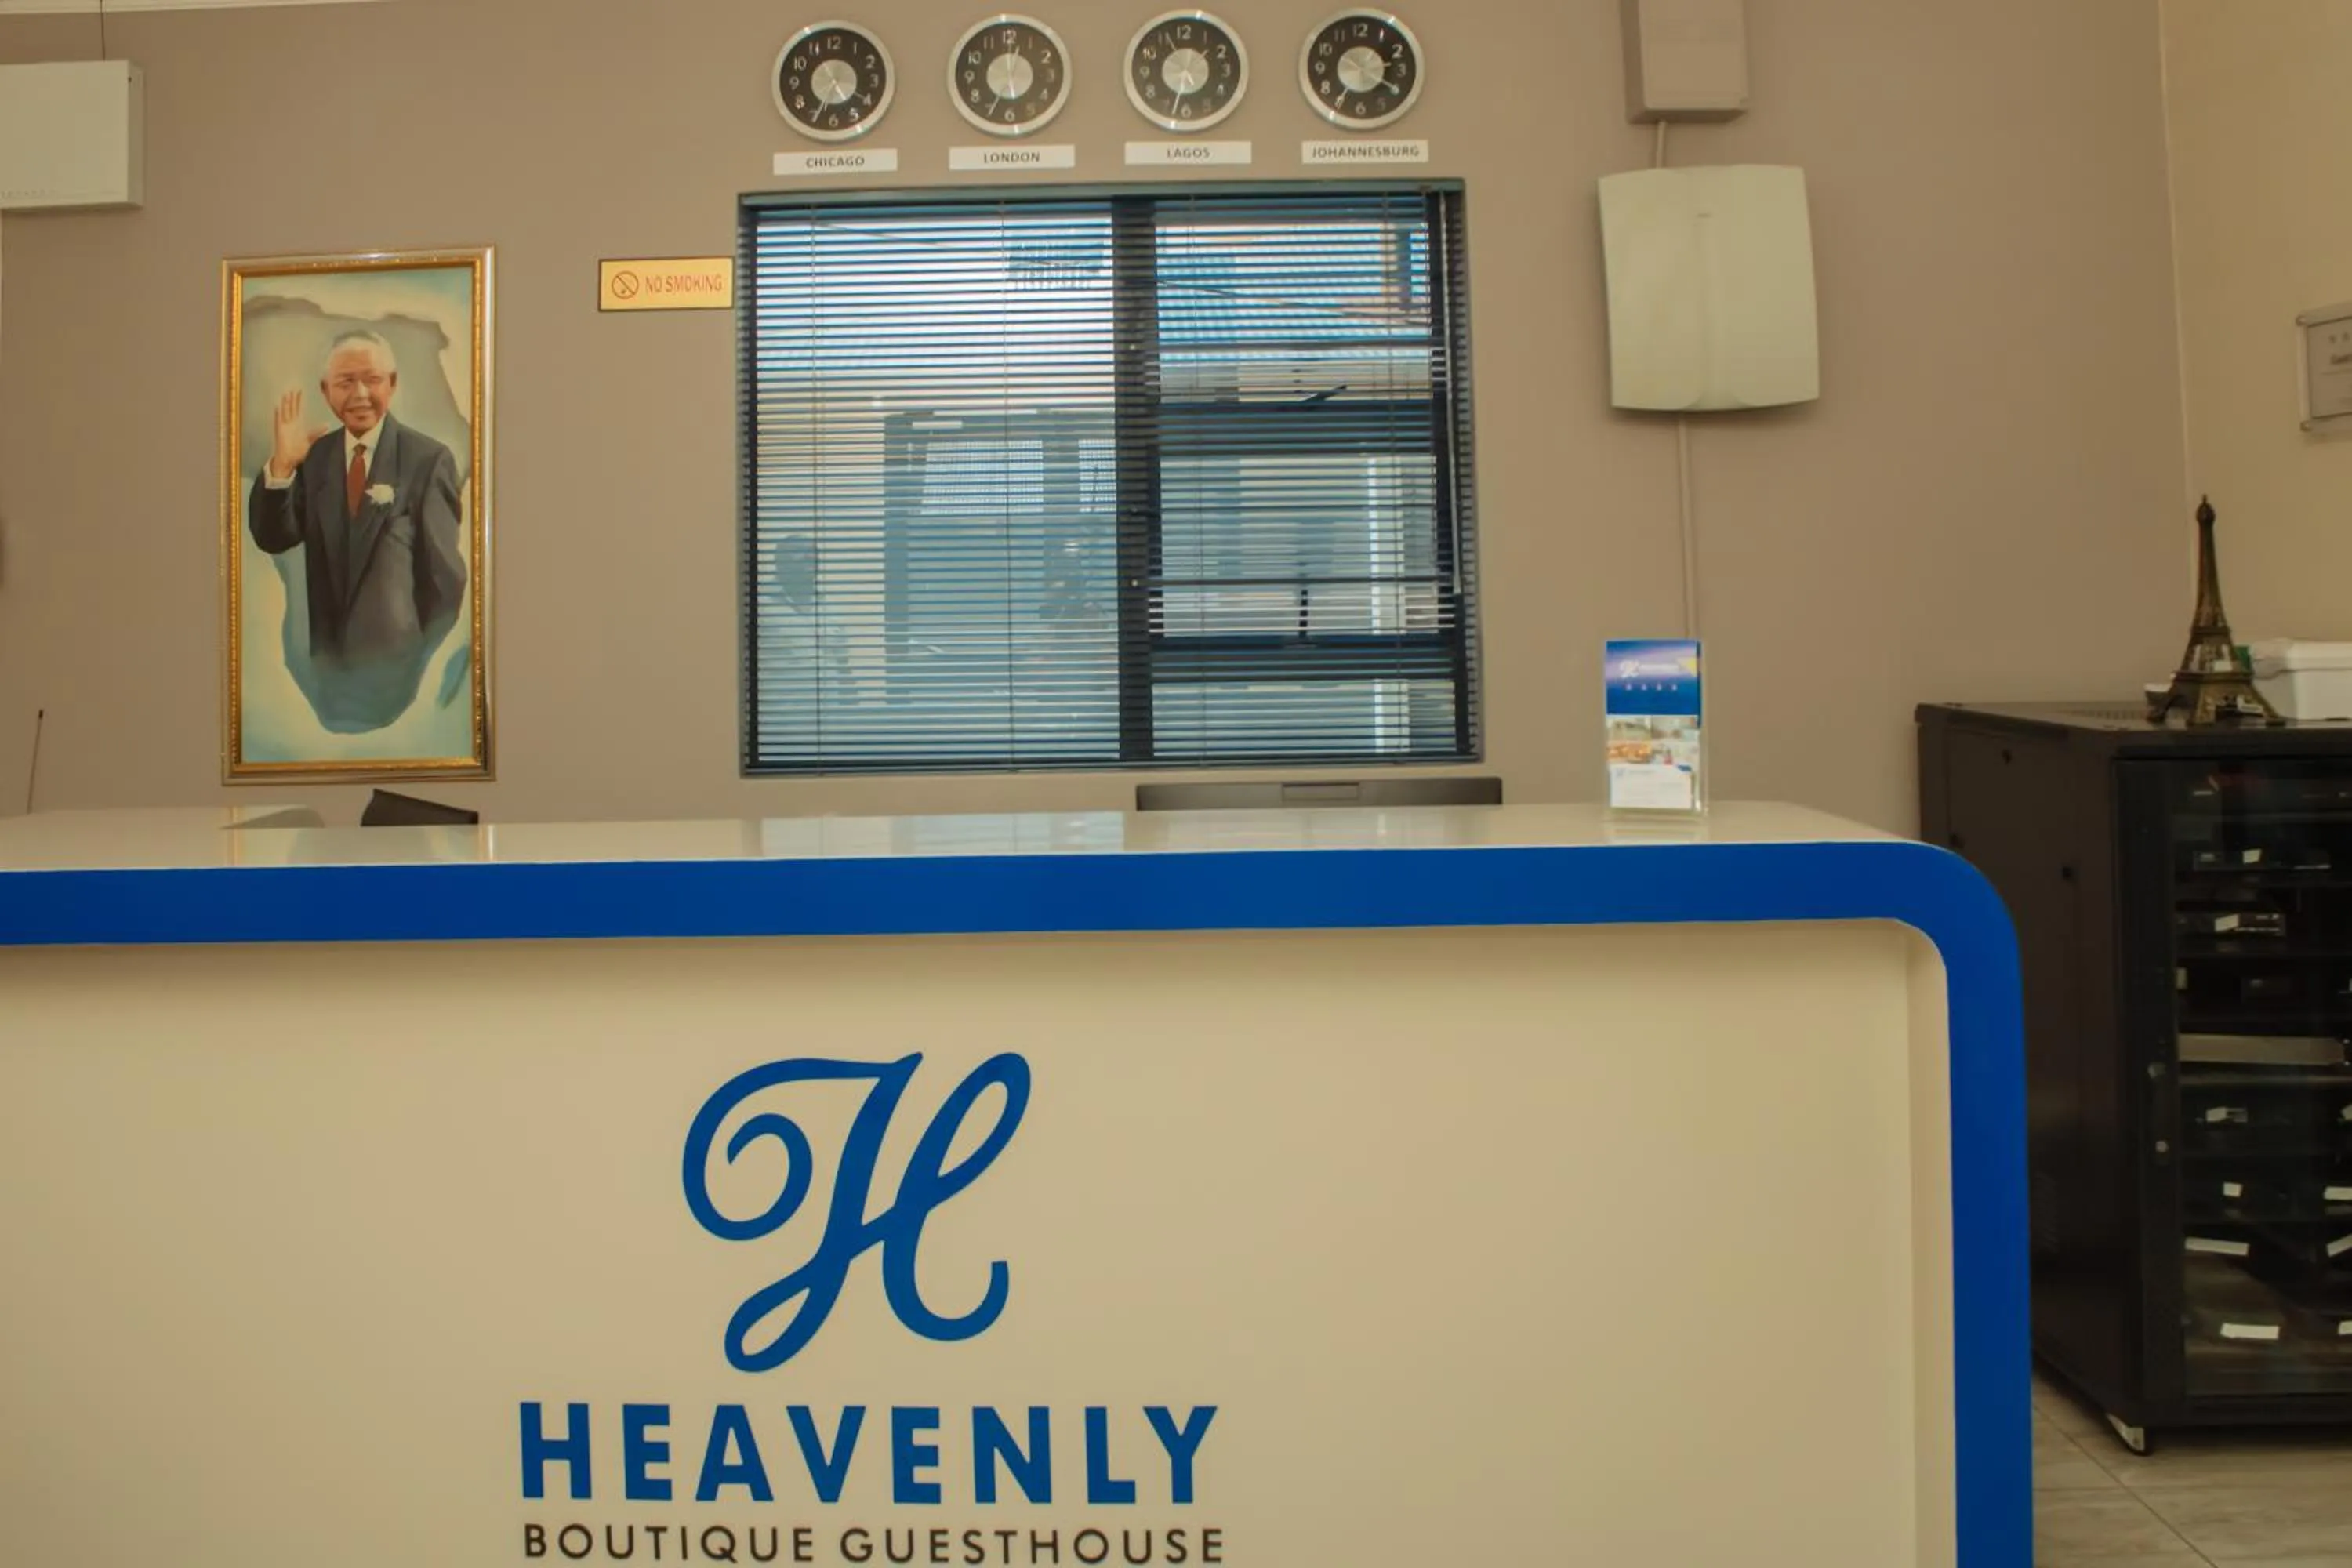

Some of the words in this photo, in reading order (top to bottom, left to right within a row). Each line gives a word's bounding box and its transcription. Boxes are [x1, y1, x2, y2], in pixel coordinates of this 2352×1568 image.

[1003, 29, 1017, 44] 12
[1177, 25, 1191, 39] 12
[1334, 29, 1345, 42] 11
[1353, 23, 1368, 37] 12
[809, 42, 819, 55] 11
[827, 36, 841, 50] 12
[984, 36, 993, 49] 11
[1319, 42, 1332, 56] 10
[968, 51, 981, 64] 10
[1041, 50, 1051, 64] 2
[1143, 47, 1156, 60] 10
[1217, 45, 1226, 58] 2
[1392, 44, 1403, 58] 2
[793, 56, 807, 71] 10
[865, 55, 875, 68] 2
[1315, 61, 1325, 75] 9
[964, 71, 975, 84] 9
[1046, 69, 1054, 82] 3
[1139, 66, 1150, 79] 9
[1222, 64, 1231, 77] 3
[1397, 64, 1406, 77] 3
[789, 76, 800, 89] 9
[869, 74, 879, 87] 3
[1320, 80, 1330, 95] 8
[971, 89, 979, 103] 8
[1040, 88, 1048, 100] 4
[1145, 84, 1155, 99] 8
[795, 95, 804, 109] 8
[1356, 102, 1366, 115] 6
[1377, 97, 1385, 111] 5
[849, 107, 858, 121] 5
[1004, 107, 1015, 122] 6
[1026, 103, 1035, 116] 5
[1181, 103, 1192, 118] 6
[829, 114, 838, 127] 6
[983, 151, 1040, 165] LONDON
[1166, 147, 1211, 158] LAGOS
[1312, 145, 1420, 158] JOHANNESBURG
[805, 155, 866, 169] CHICAGO
[645, 274, 662, 294] NO
[666, 273, 723, 293] SMOKING
[519, 1400, 1218, 1505] HEAVENLY
[524, 1523, 814, 1564] BOUTIQUE
[840, 1527, 1223, 1566] GUESTHOUSE
